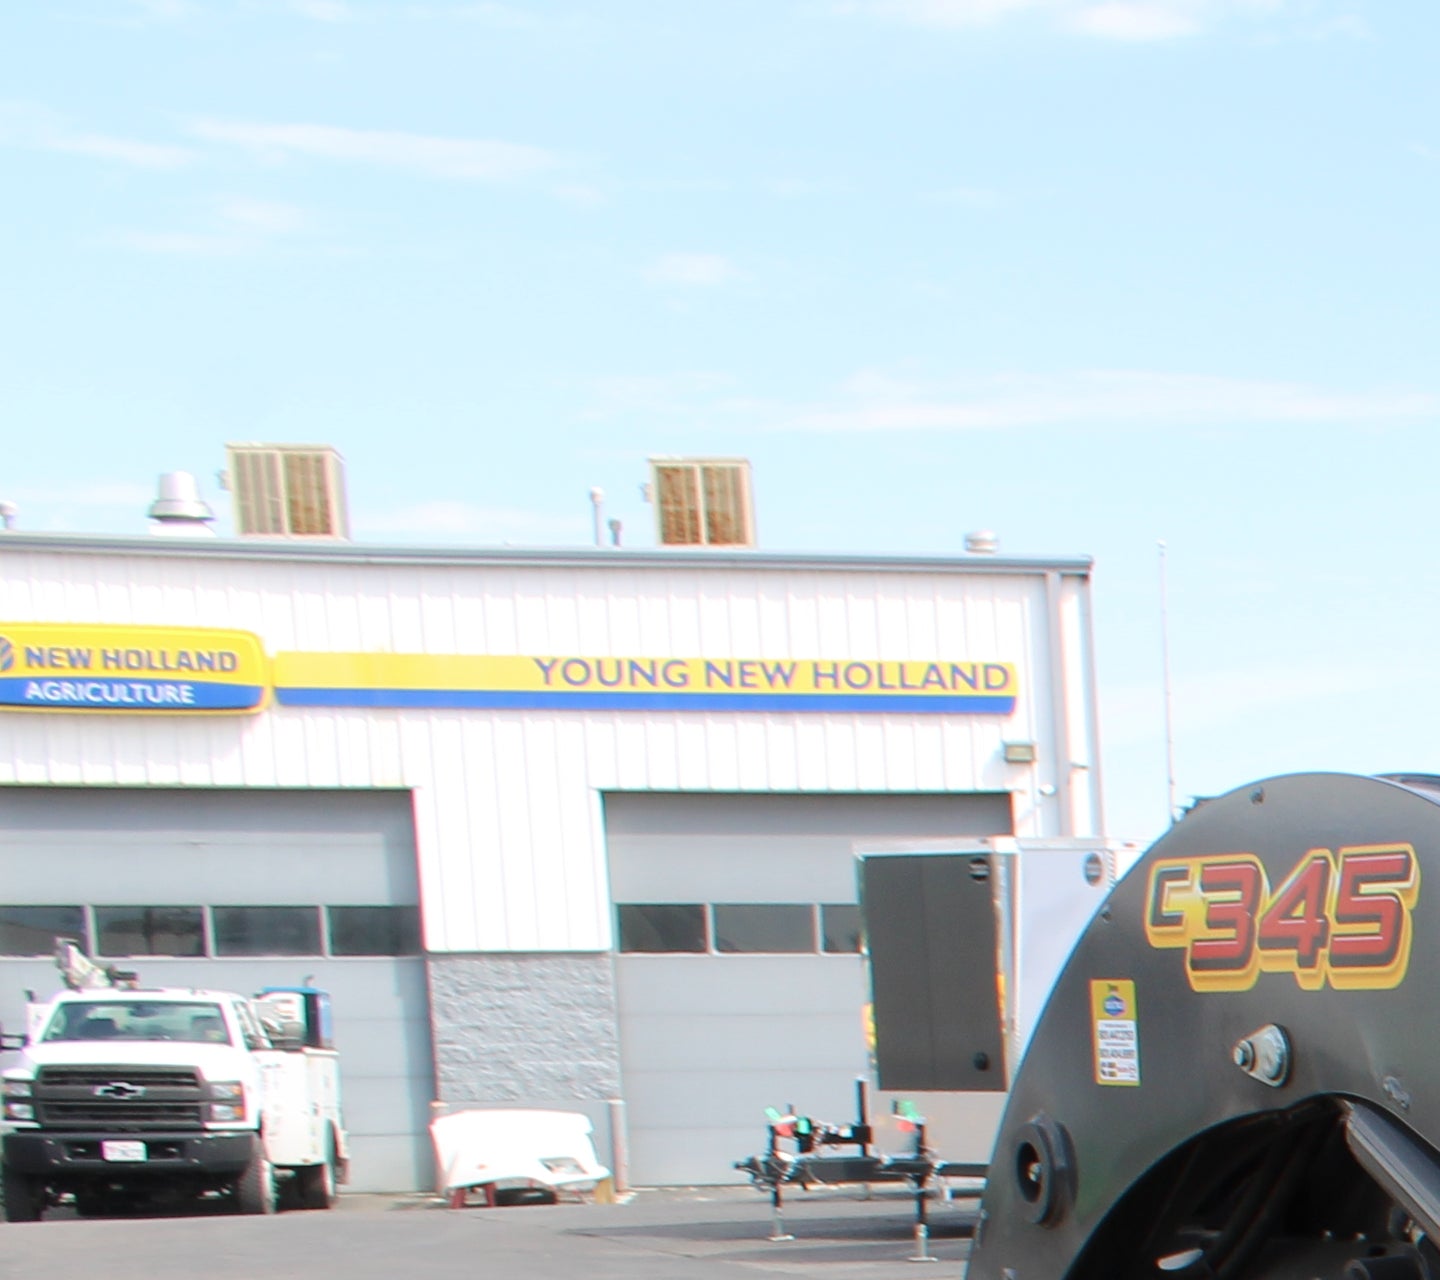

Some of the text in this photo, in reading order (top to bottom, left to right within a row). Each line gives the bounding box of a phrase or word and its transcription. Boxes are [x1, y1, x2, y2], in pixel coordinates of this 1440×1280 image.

[24, 646, 239, 672] NEW HOLLAND
[533, 656, 1010, 691] YOUNG NEW HOLLAND
[25, 680, 196, 704] AGRICULTURE
[1145, 843, 1421, 991] C345
